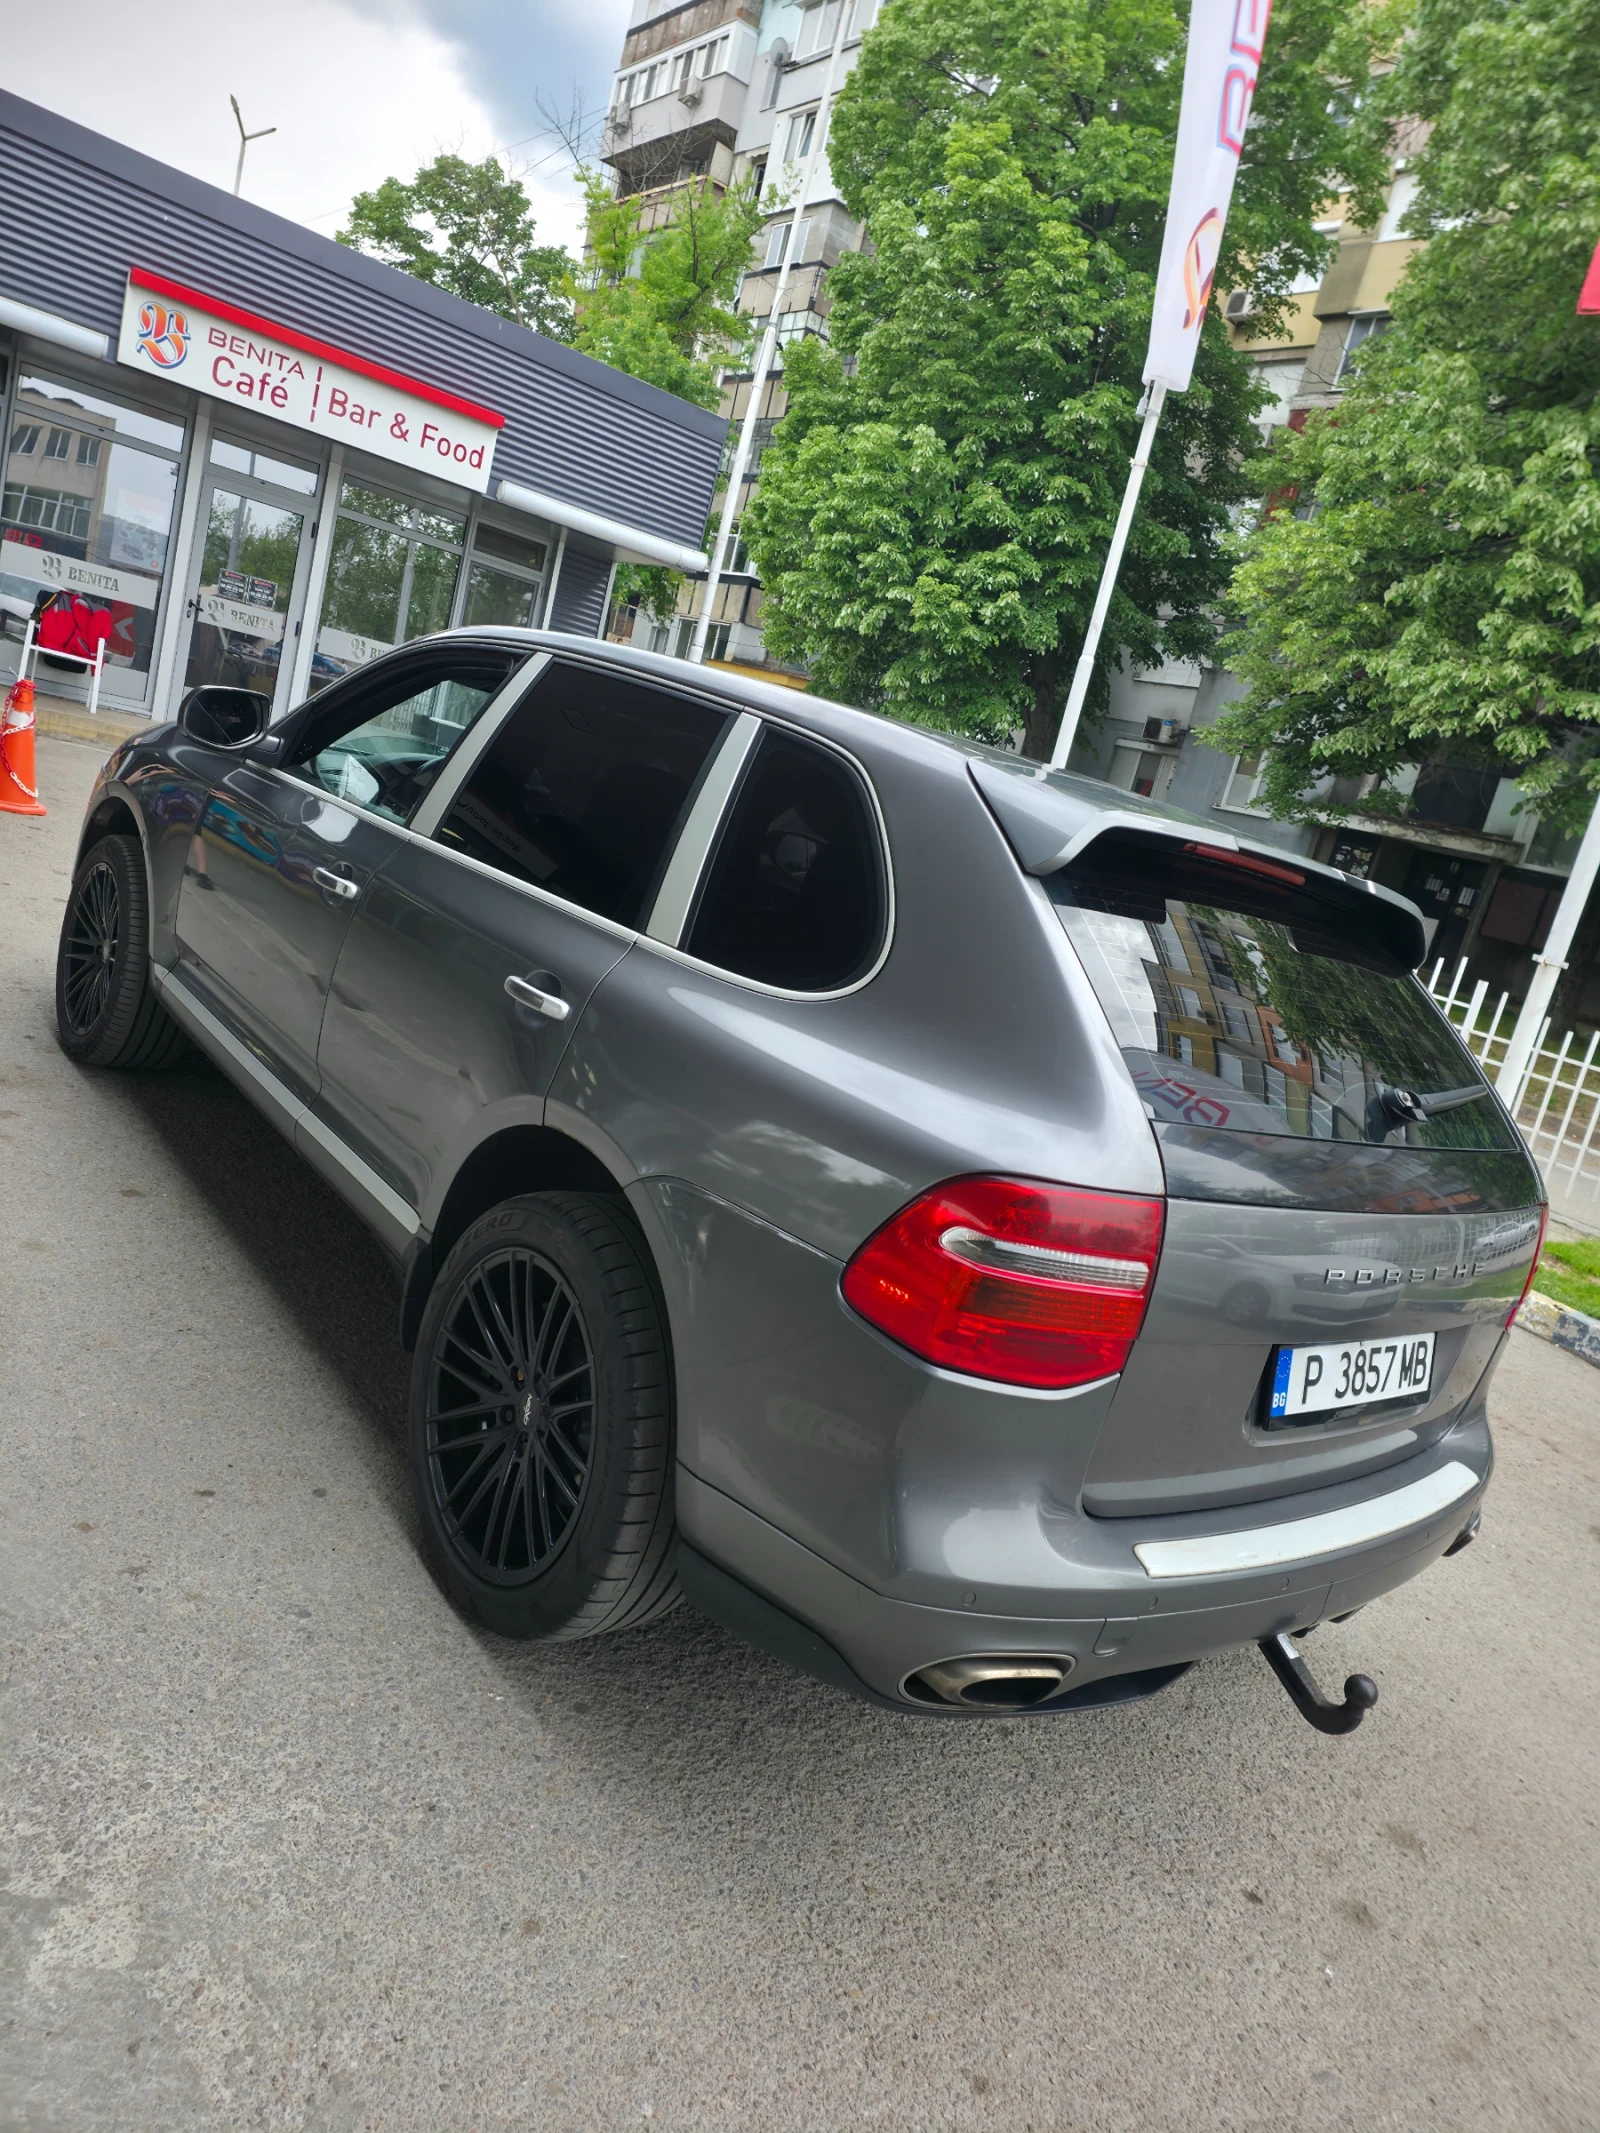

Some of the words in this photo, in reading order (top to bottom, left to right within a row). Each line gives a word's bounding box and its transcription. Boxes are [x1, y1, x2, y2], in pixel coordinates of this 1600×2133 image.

[208, 326, 305, 380] BENITA
[212, 354, 289, 409] Café
[328, 387, 382, 429] Bar
[389, 412, 410, 443] &
[420, 422, 485, 470] Food
[68, 566, 120, 592] BENITA
[230, 609, 275, 633] BENITA
[1324, 1262, 1486, 1285] PORSCHE
[1301, 1354, 1323, 1405] P
[1334, 1345, 1398, 1399] 3857
[1272, 1391, 1286, 1408] BG
